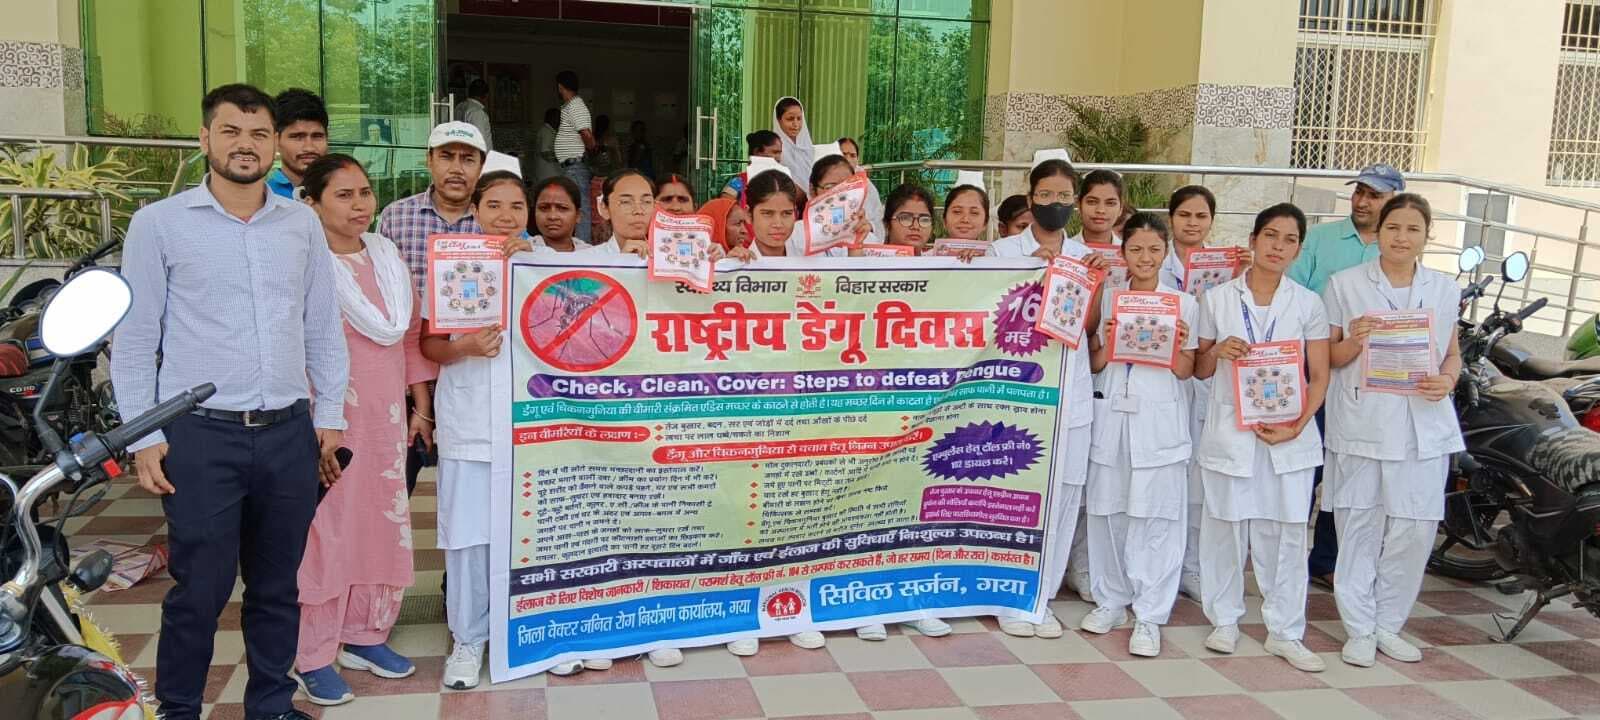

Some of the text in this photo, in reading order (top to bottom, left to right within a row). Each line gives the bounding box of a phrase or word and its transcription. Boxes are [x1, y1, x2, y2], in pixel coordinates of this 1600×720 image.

[735, 275, 787, 294] विभाग
[835, 275, 929, 294] बिहार सरकार
[1008, 293, 1042, 322] 16
[645, 299, 989, 364] राष्ट्रीय डेंगू दिवस
[1004, 326, 1032, 347] मई
[552, 376, 633, 396] Check,
[640, 376, 709, 394] Clean,
[716, 375, 785, 391] Cover:
[793, 374, 849, 391] Steps
[855, 371, 876, 387] to
[881, 371, 950, 387] defeat
[520, 567, 557, 585] सभी
[559, 557, 620, 581] सरकारी
[622, 554, 698, 572] अस्पतालों
[700, 552, 717, 566] में
[718, 551, 750, 565] जाँच
[753, 547, 778, 562] एवं
[821, 536, 843, 552] की
[845, 529, 897, 551] सुविधाएँ
[959, 528, 1013, 542] उपलब्ध
[546, 592, 557, 606] के
[819, 579, 895, 608] सिविल
[898, 572, 967, 598] सर्जन,
[975, 577, 1029, 597] गया
[518, 597, 752, 648] जिला वेक्टर जनित रोग नियंत्रण कार्यालय, गया
